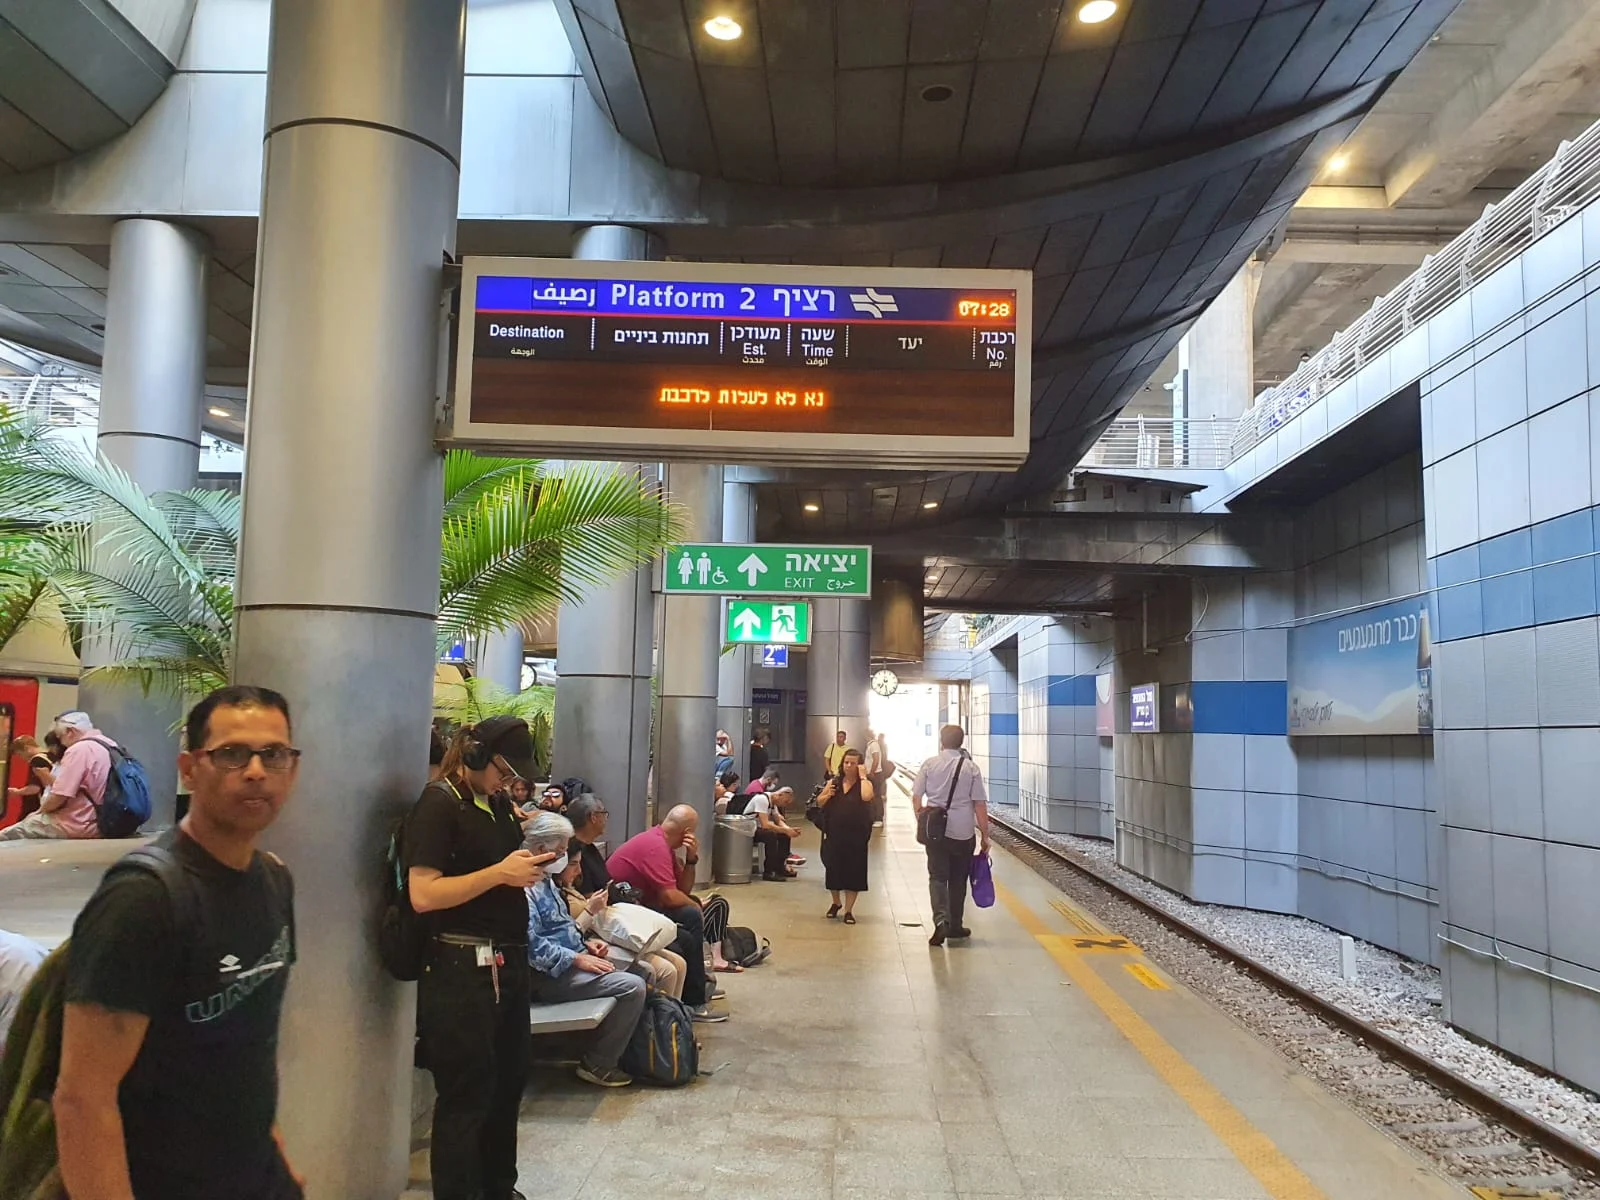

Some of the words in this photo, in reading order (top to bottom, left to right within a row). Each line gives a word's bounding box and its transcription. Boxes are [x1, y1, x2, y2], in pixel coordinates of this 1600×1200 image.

[533, 282, 596, 306] رصيف
[611, 283, 725, 309] Platform
[740, 287, 756, 310] 2
[773, 288, 835, 317] רציף
[958, 300, 1010, 317] 07:28
[489, 323, 565, 339] Destination
[614, 329, 657, 343] ביניים
[662, 331, 709, 345] תחנות
[730, 326, 780, 342] מעודכן
[801, 328, 835, 341] שעה
[980, 331, 1015, 344] רכבת
[743, 343, 767, 356] Est.
[802, 344, 834, 357] Time
[898, 337, 923, 350] יעד
[986, 348, 1008, 360] No.
[659, 388, 710, 403] לרכבת
[717, 390, 769, 405] לעלות
[775, 391, 797, 406] לא
[804, 392, 825, 407] נא
[785, 553, 857, 573] יציאה
[784, 577, 815, 588] EXIT
[826, 578, 856, 591] خروج
[1393, 614, 1417, 642] כבר
[1338, 620, 1391, 652] מתגעגעים
